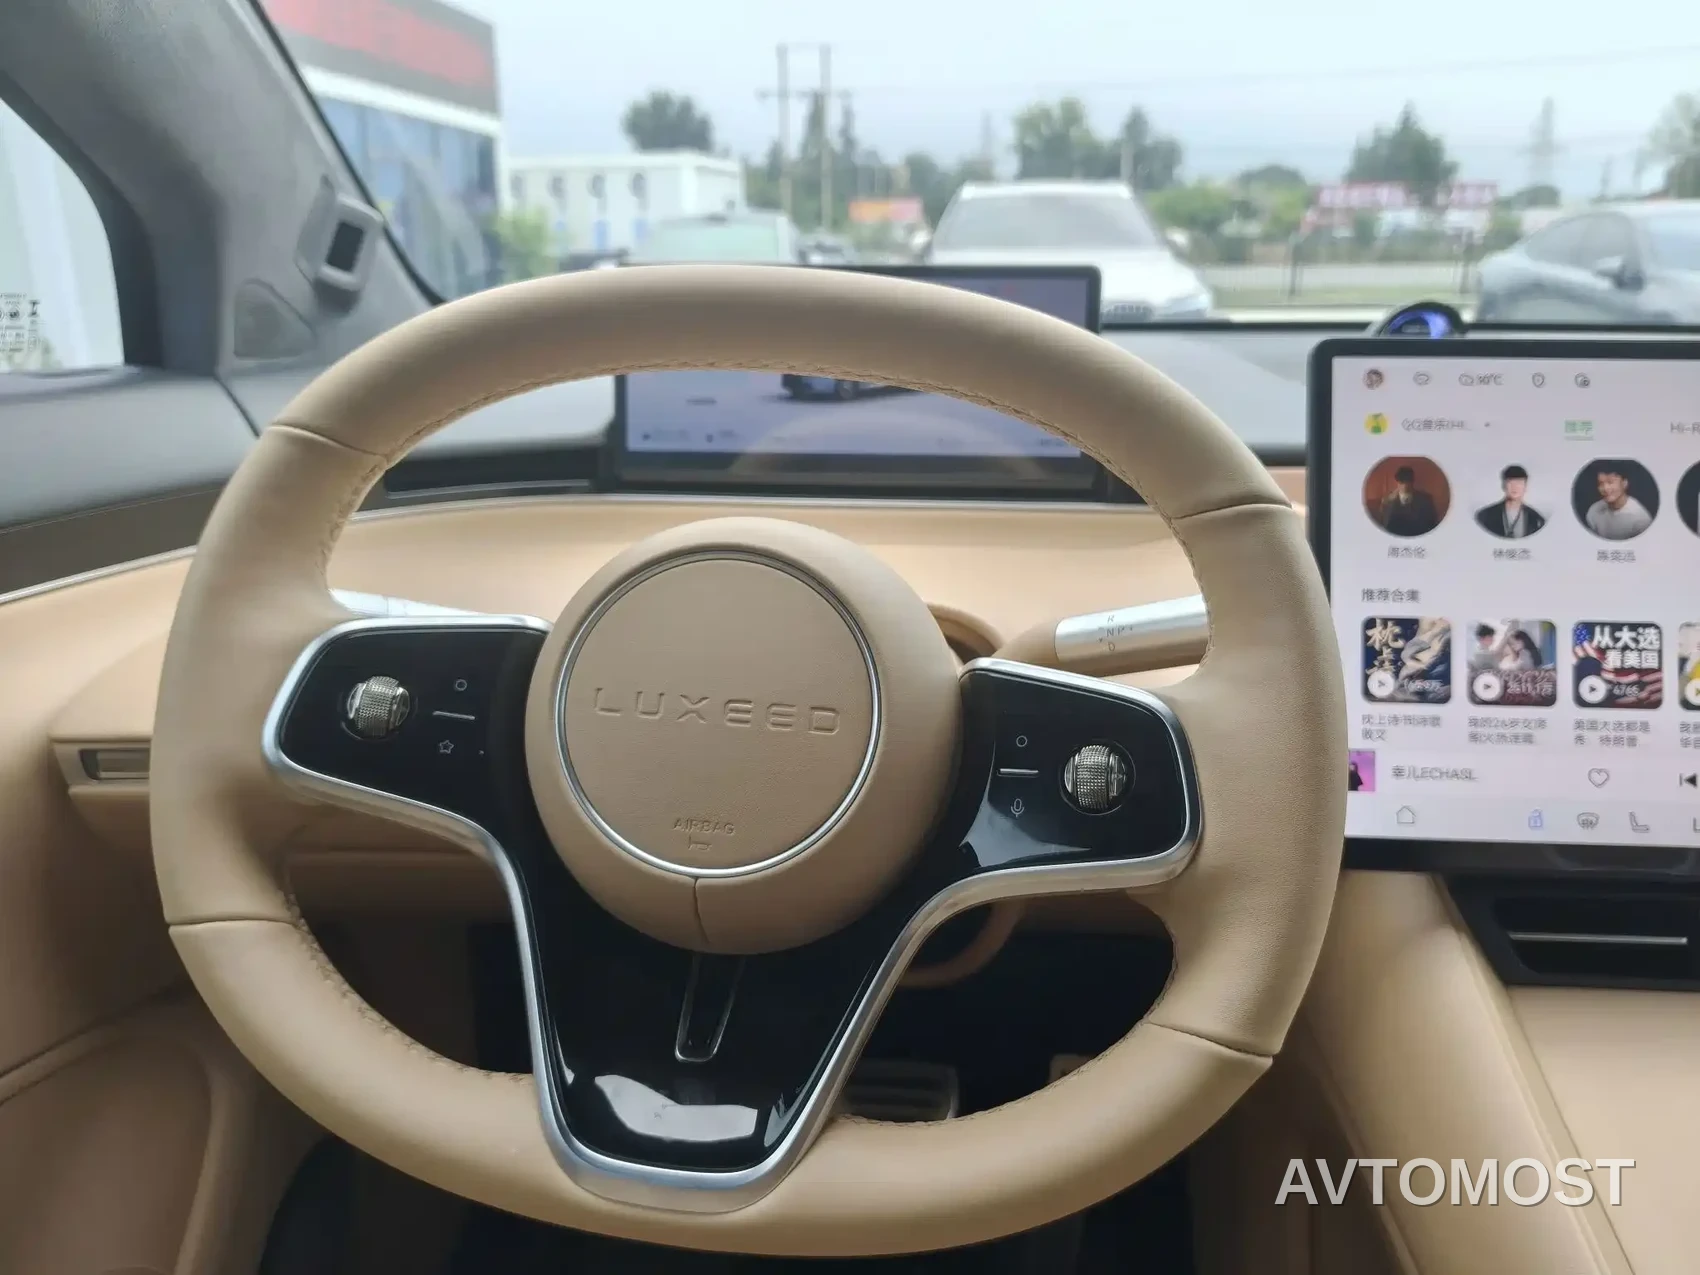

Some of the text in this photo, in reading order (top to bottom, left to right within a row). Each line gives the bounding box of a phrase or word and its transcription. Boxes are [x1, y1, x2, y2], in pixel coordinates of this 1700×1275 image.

[1361, 588, 1421, 602] 推荐合集
[1107, 641, 1116, 652] D
[1592, 625, 1660, 650] 从大选
[1604, 649, 1659, 669] 看美国
[594, 687, 841, 736] LUXEED
[672, 816, 736, 836] AIRBAG
